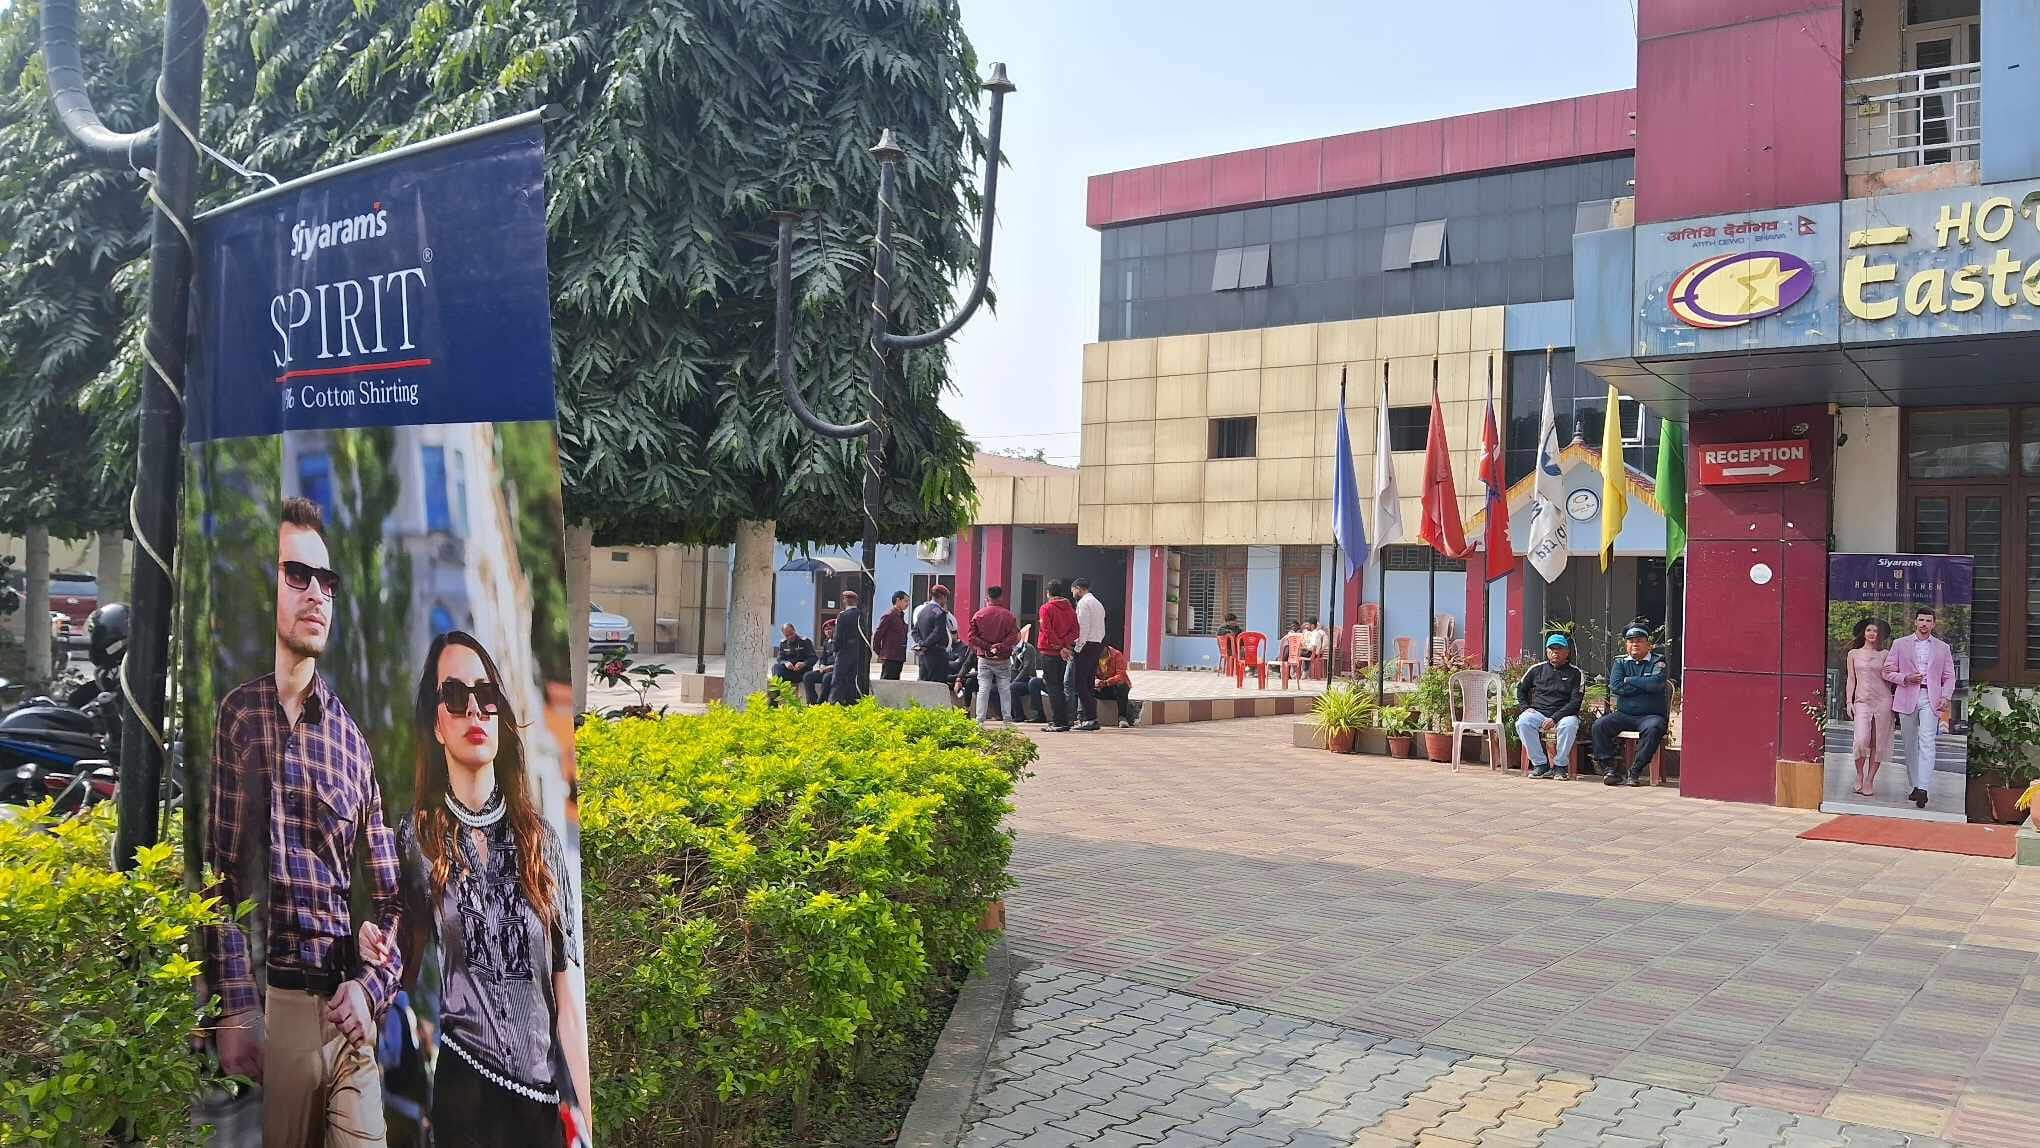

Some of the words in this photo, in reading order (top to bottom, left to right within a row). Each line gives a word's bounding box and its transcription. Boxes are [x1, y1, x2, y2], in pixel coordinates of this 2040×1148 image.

[270, 267, 428, 369] SPIRIT
[301, 385, 356, 409] Cotton
[359, 378, 419, 406] Shirting
[1705, 446, 1804, 465] RECEPTION
[1906, 582, 1942, 591] LINEN
